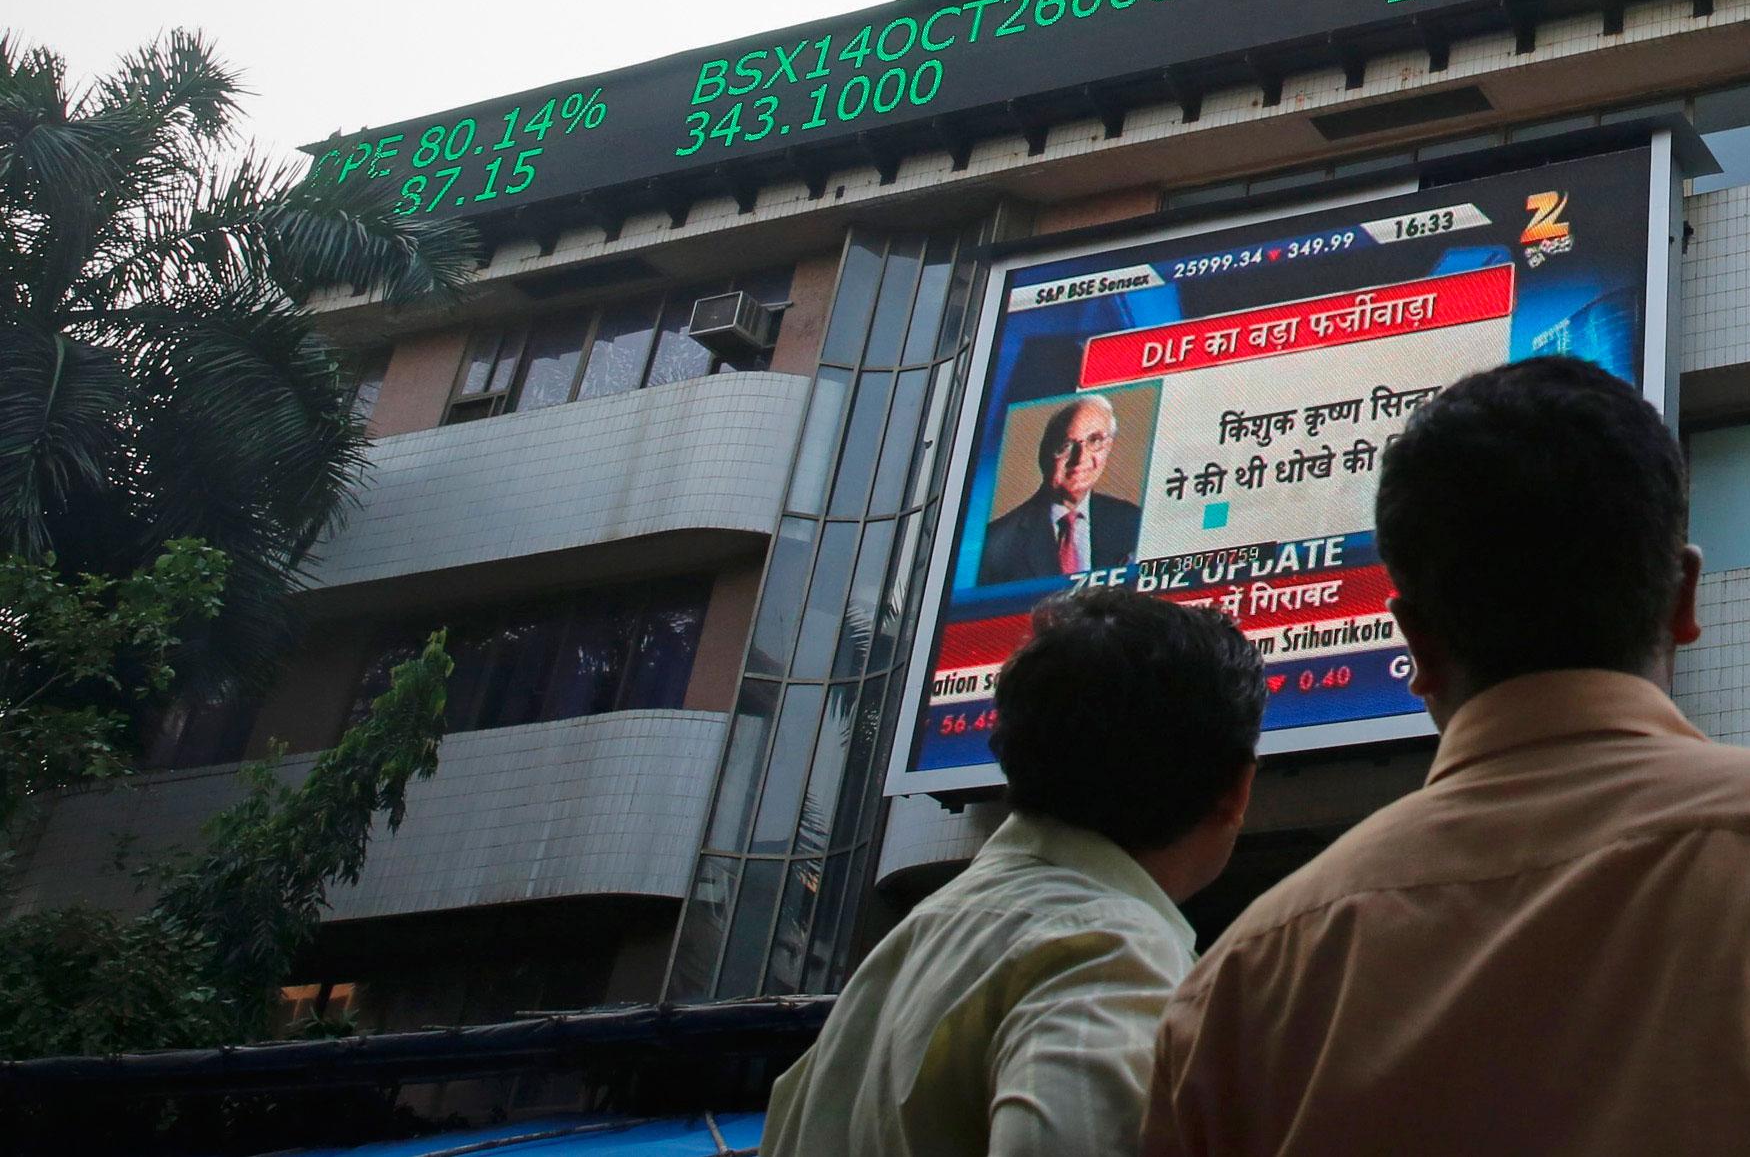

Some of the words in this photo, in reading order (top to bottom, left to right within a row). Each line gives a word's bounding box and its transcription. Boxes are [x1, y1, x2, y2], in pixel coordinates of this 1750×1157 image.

[411, 87, 608, 169] 80.14%
[674, 58, 945, 158] 343.1000
[392, 146, 545, 216] 87.15
[1034, 280, 1065, 305] S&P
[1066, 277, 1096, 300] BSE
[1098, 271, 1150, 297] Sensex
[1172, 248, 1263, 279] 25999.34
[1287, 231, 1355, 260] 349.99
[1393, 211, 1455, 239] 16:33
[1140, 334, 1197, 368] DLF
[1204, 327, 1241, 357] का
[1247, 318, 1302, 351] बड़ा
[1218, 409, 1299, 448] किंशुक
[1303, 398, 1364, 437] कृष्ण
[1166, 467, 1188, 501] ने
[1193, 462, 1228, 497] की
[1234, 455, 1268, 490] थी
[1275, 445, 1337, 484] धोखे
[1342, 438, 1378, 474] की
[1249, 579, 1344, 616] गिरावट
[1280, 617, 1394, 653] Sriharikota
[1298, 665, 1352, 691] 0.40
